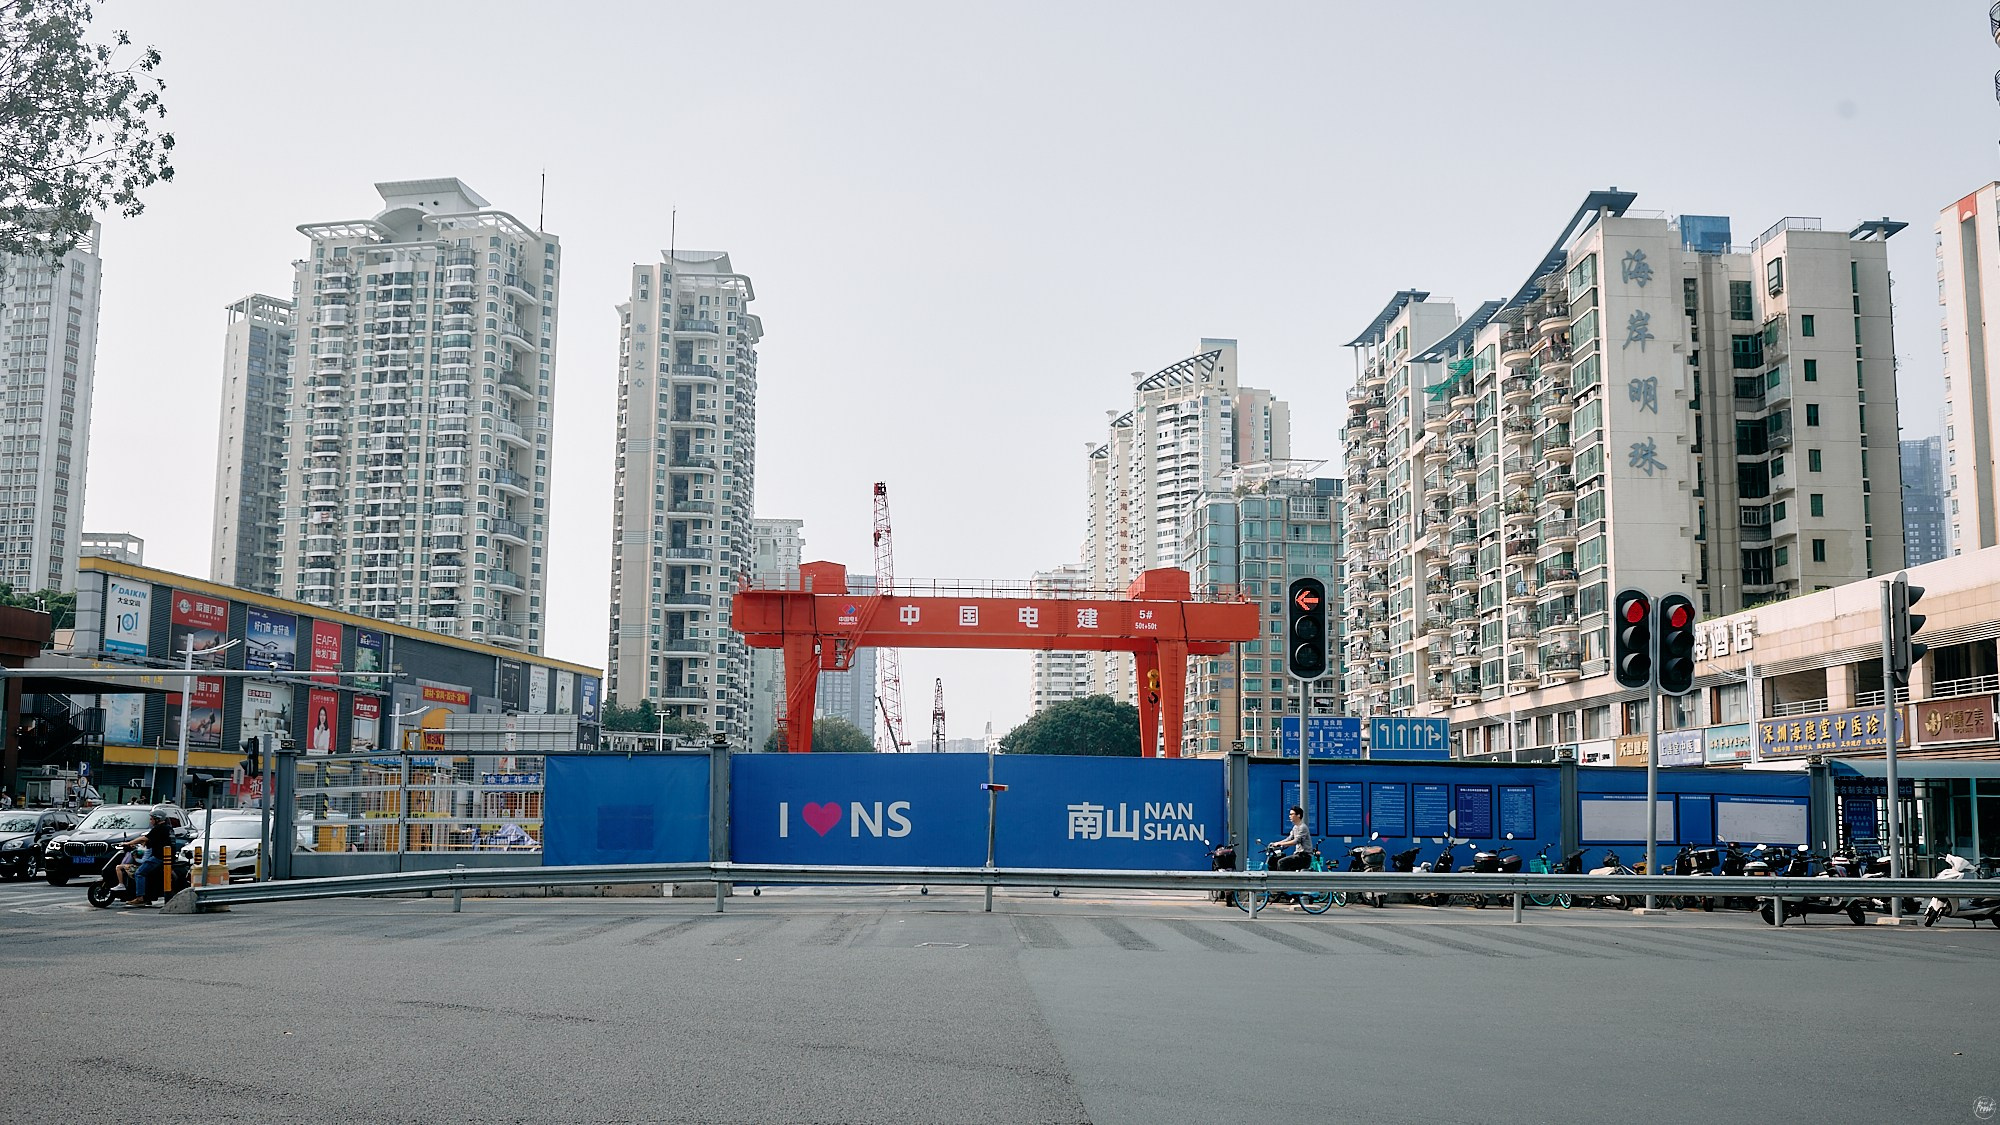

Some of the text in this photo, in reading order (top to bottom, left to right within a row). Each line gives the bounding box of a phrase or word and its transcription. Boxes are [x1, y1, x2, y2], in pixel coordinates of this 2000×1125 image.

[634, 322, 647, 388] 海洋之心
[1620, 248, 1667, 477] 海岸明珠
[1119, 488, 1128, 566] 云海天城世家
[117, 597, 141, 608] 大金空调
[119, 587, 148, 599] DAIKIN
[116, 611, 139, 634] 101
[900, 605, 1099, 629] 中国电建
[1139, 610, 1153, 620] 5#
[1135, 622, 1158, 631] 50t+50t
[315, 633, 338, 647] EAFA
[81, 763, 87, 776] P
[779, 801, 912, 837] I NS
[1067, 802, 1140, 841] 南山
[1144, 803, 1193, 820] NAN
[1143, 822, 1206, 842] SHAN
